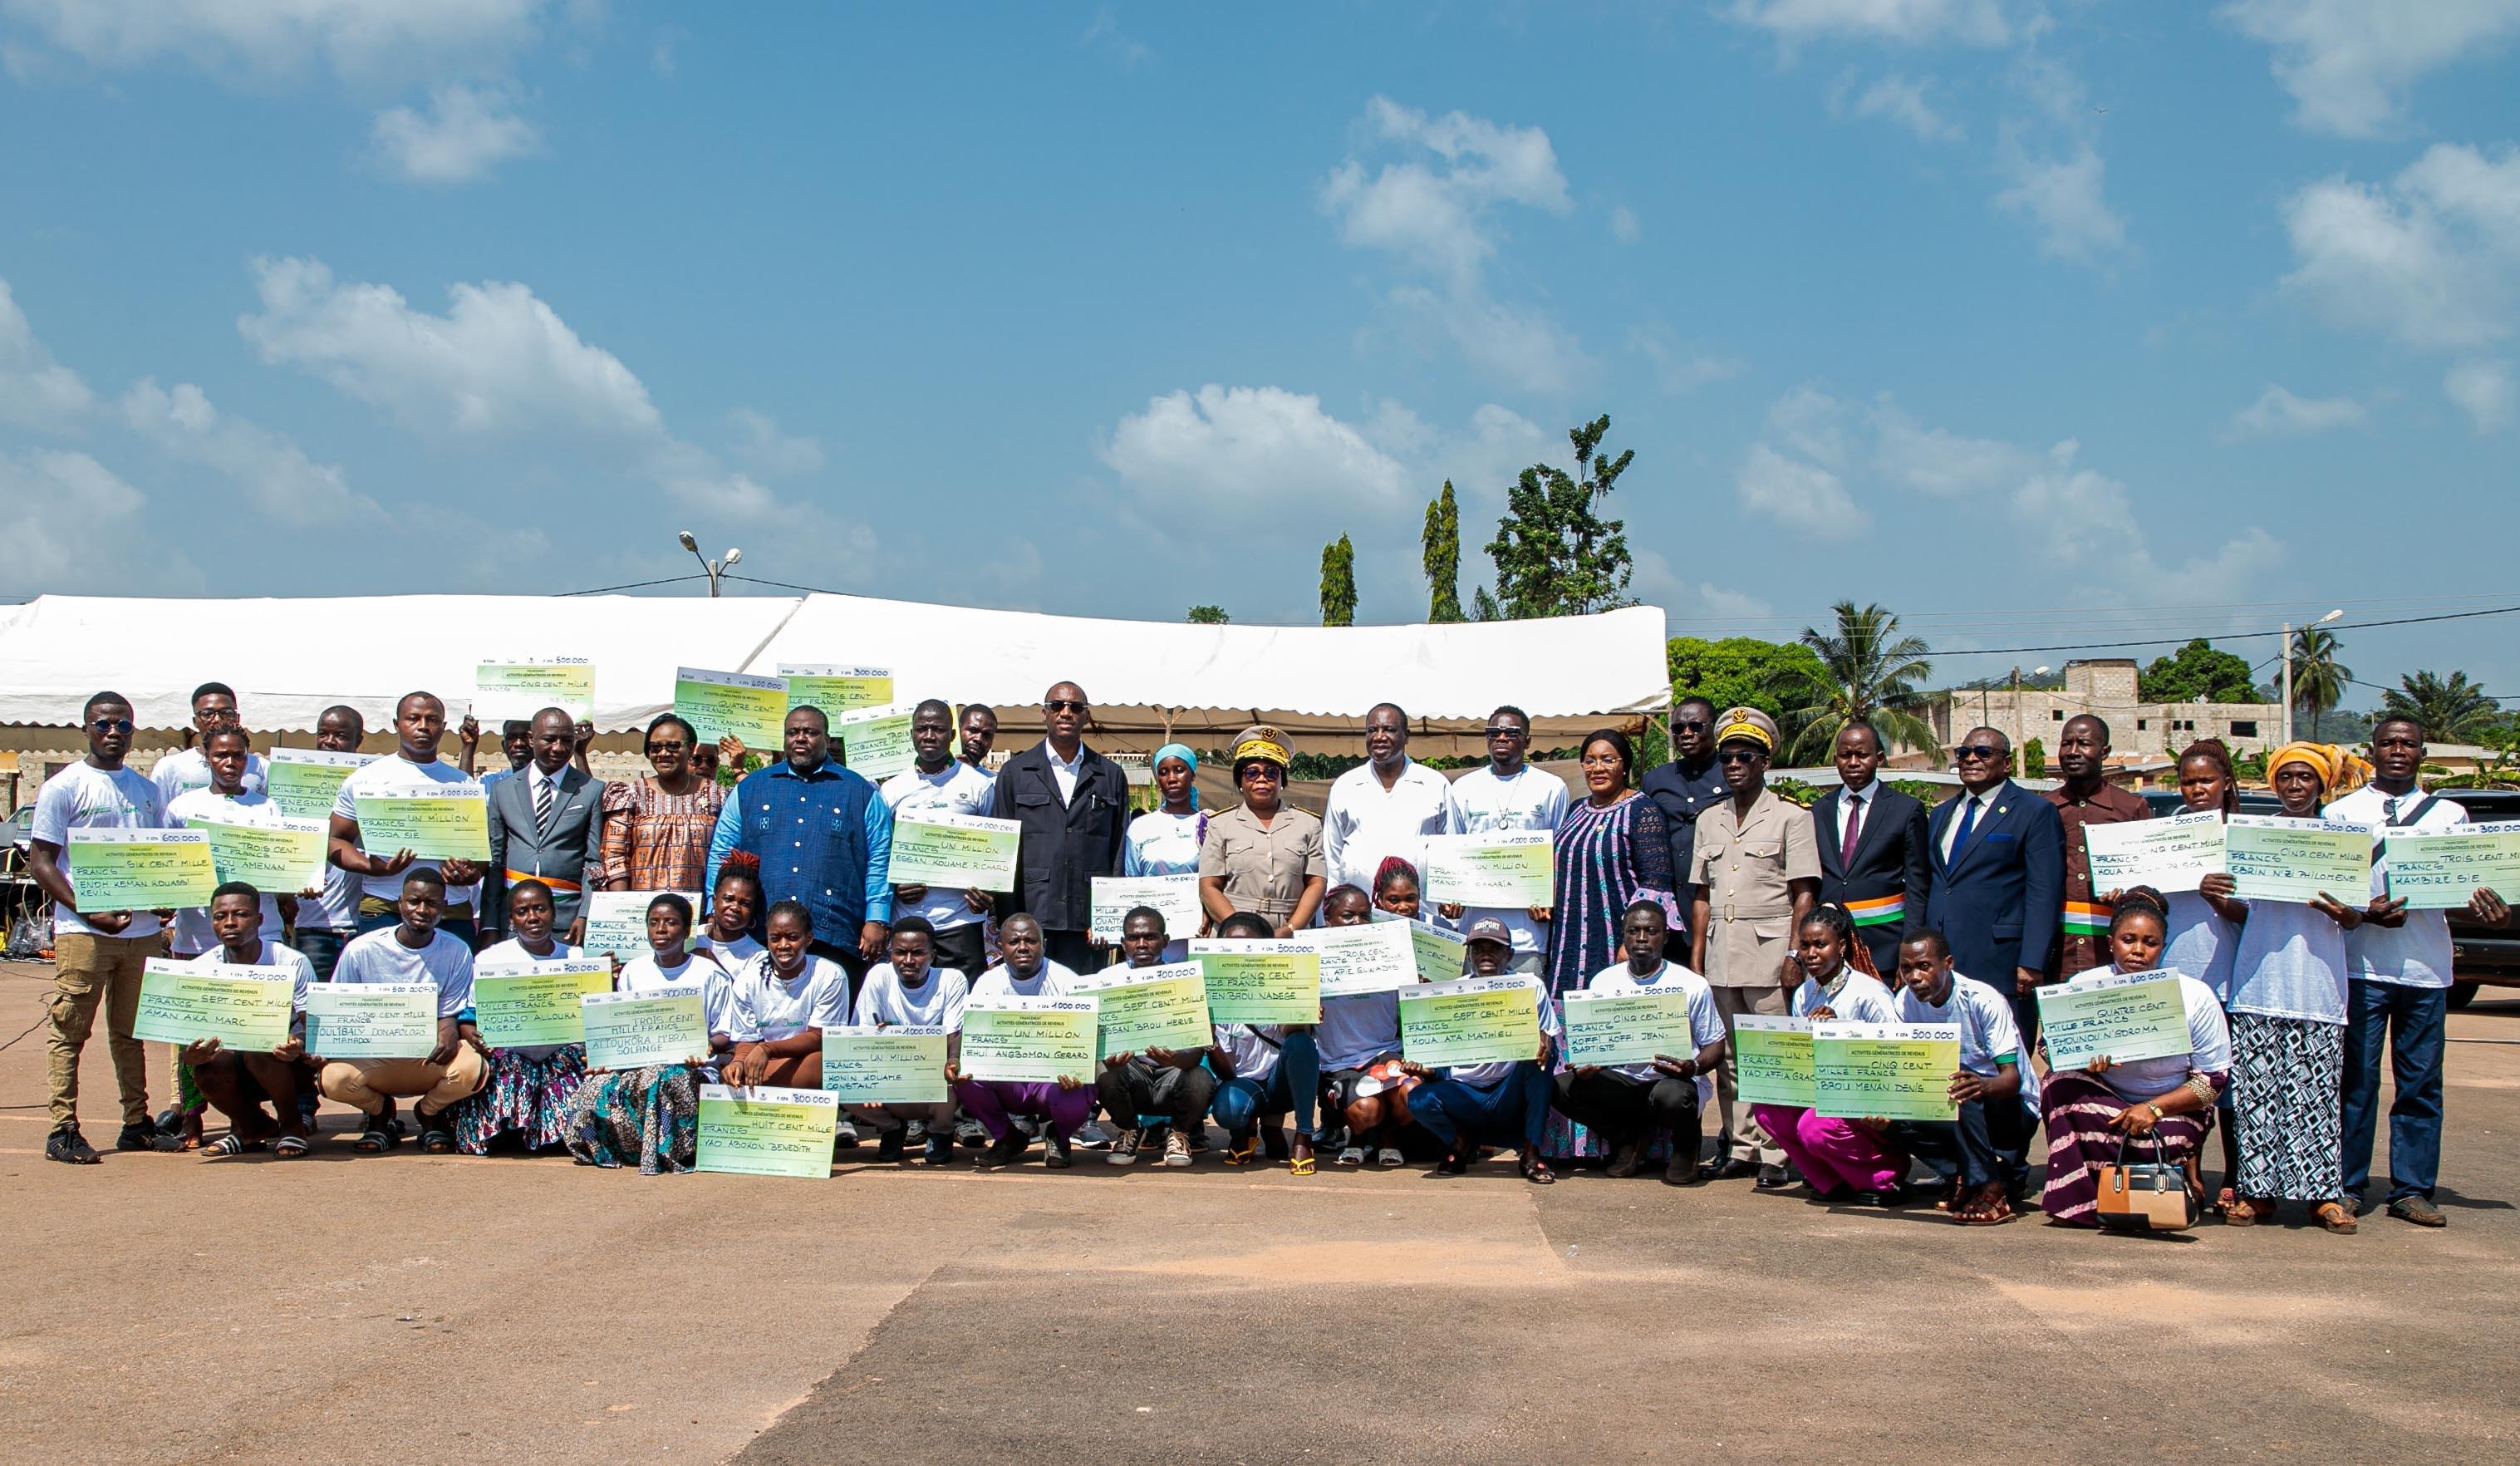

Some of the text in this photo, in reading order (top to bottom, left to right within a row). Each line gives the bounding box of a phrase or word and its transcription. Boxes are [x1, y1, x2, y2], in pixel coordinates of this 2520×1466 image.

[238, 843, 270, 853] TROIS
[898, 844, 938, 854] FRANCS
[229, 849, 270, 858] FRANCS
[2232, 853, 2282, 862] FRANCS
[2281, 848, 2307, 857] CINQ
[2310, 849, 2335, 859] CENT
[1240, 972, 1265, 981] CINQ
[201, 995, 228, 1005] SEPT
[234, 998, 262, 1006] CENT
[528, 993, 554, 1001] SEPT
[148, 997, 191, 1008] FRANCS
[1123, 1001, 1147, 1011] SEPT
[1152, 999, 1177, 1008] CENT
[1181, 994, 1205, 1004] MILLE
[1454, 1007, 1530, 1021] SEPT CENT MILLE
[2096, 1002, 2167, 1017] QUATRE CENT
[145, 1009, 247, 1026] AMAN AKA MARC
[632, 1014, 695, 1027] TROIS CENT
[1614, 1015, 1637, 1023] CINQ
[1572, 1023, 1614, 1031] FRANCS
[2049, 1016, 2129, 1032] MILLE FRANCS
[1037, 1030, 1081, 1038] MILLION
[1467, 1031, 1512, 1040] MATHIEU
[617, 1044, 663, 1055] SOLANGE
[1572, 1045, 1615, 1054] BAPTISTE
[1786, 1050, 1800, 1059] UN
[1743, 1055, 1781, 1065] FRANCS
[1871, 1059, 1897, 1070] CINQ
[1743, 1069, 1761, 1077] YAO
[1894, 1083, 1924, 1092] DENIS
[808, 1124, 832, 1133] MILLE
